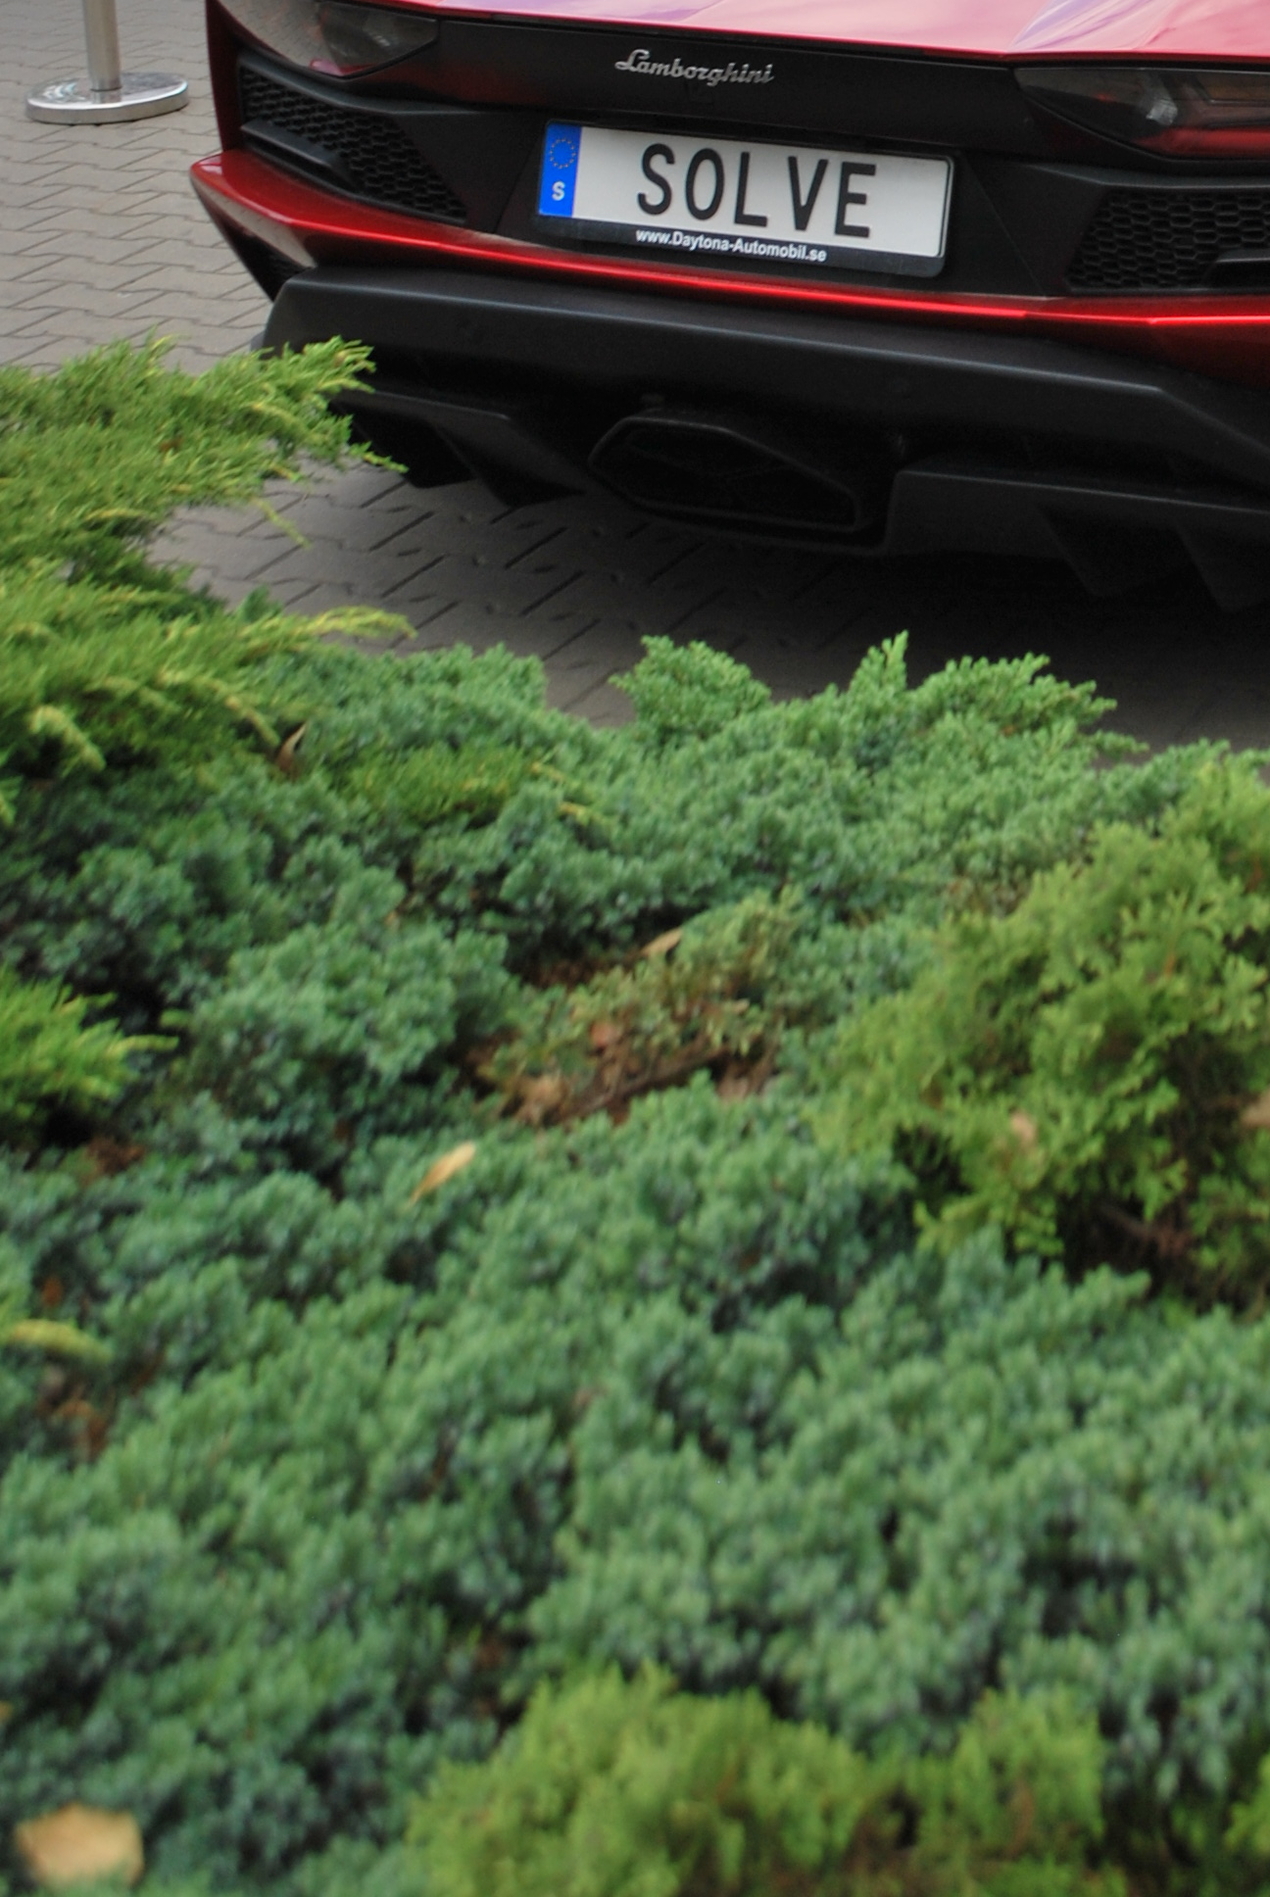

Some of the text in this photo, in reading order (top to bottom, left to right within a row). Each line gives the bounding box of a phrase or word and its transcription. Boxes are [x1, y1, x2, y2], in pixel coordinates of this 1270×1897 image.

[614, 49, 775, 87] Lamborghini
[552, 181, 565, 201] S
[636, 143, 876, 238] SOLVE
[636, 229, 827, 262] www.Daytona-Automobil.se
